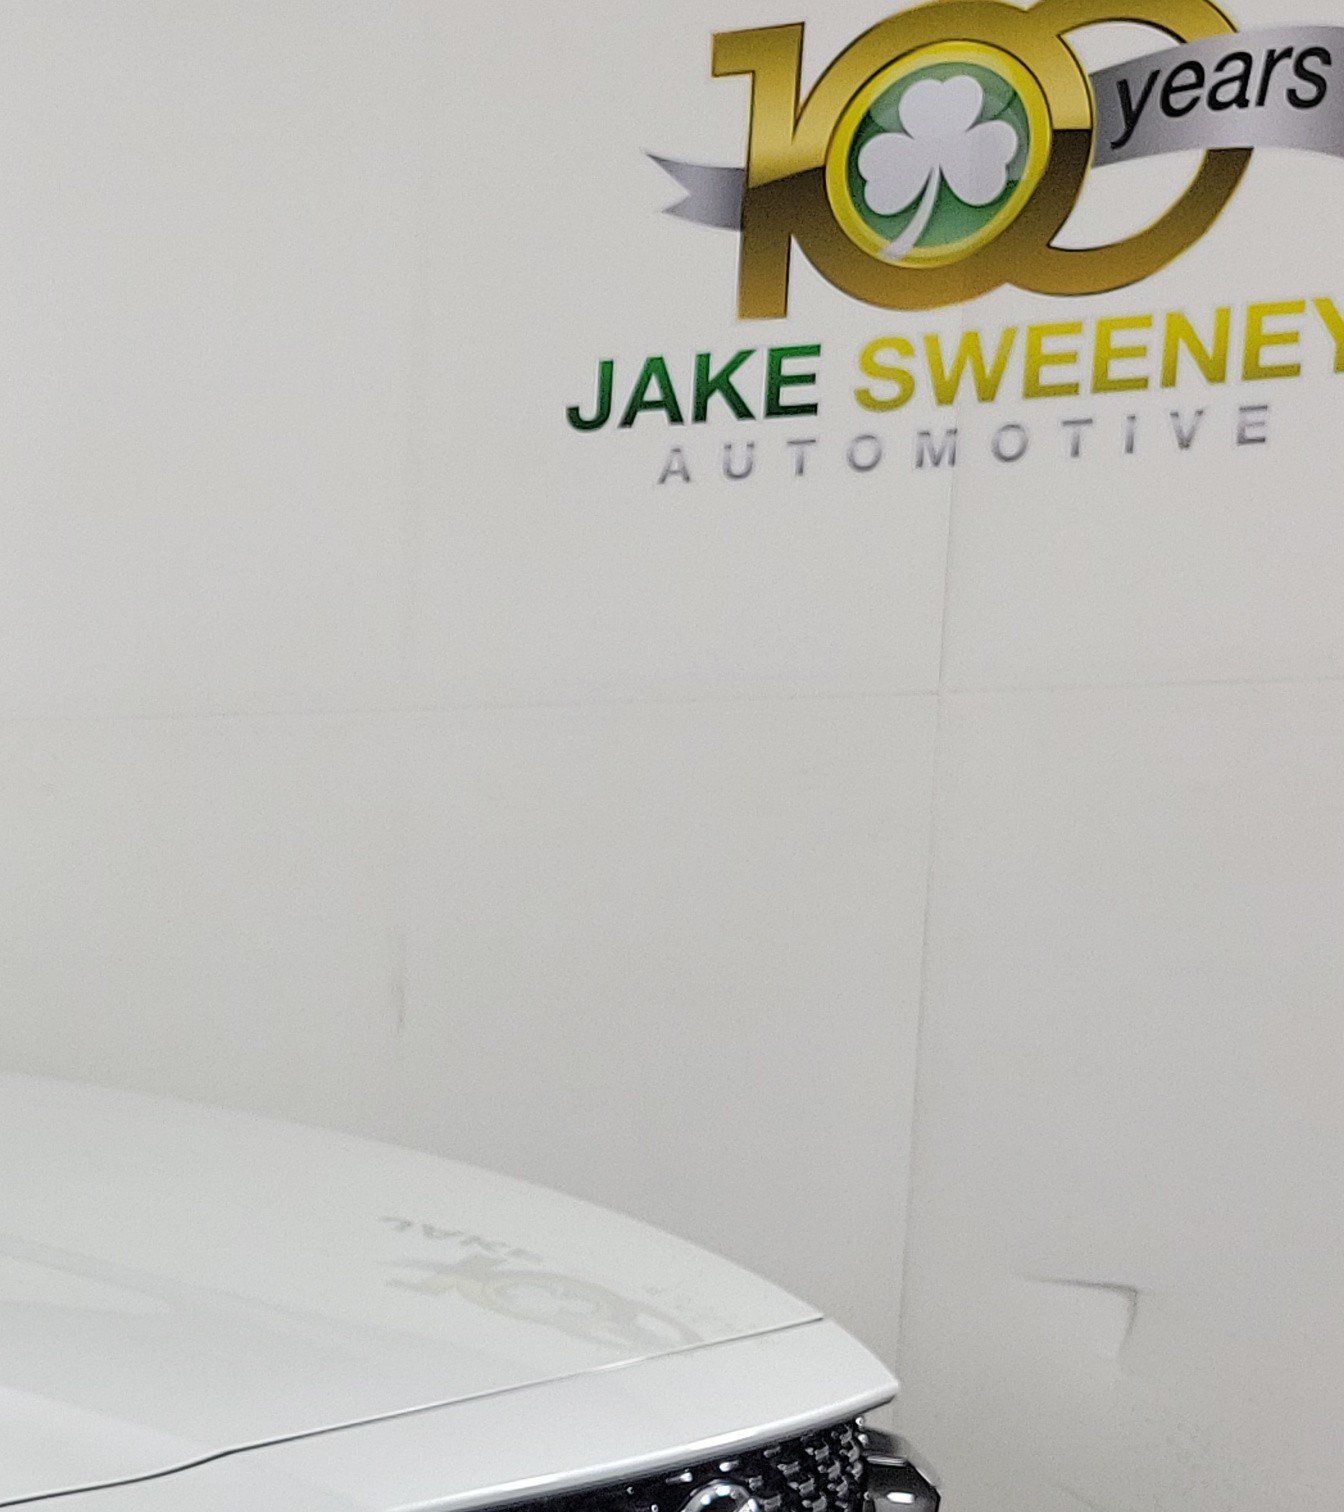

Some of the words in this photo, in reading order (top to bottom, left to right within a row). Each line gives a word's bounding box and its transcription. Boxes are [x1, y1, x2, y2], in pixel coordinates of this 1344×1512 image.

[712, 0, 1253, 319] 100
[1110, 41, 1332, 148] years
[566, 345, 821, 430] JAKE
[658, 404, 1271, 485] AUTOMOTIVE
